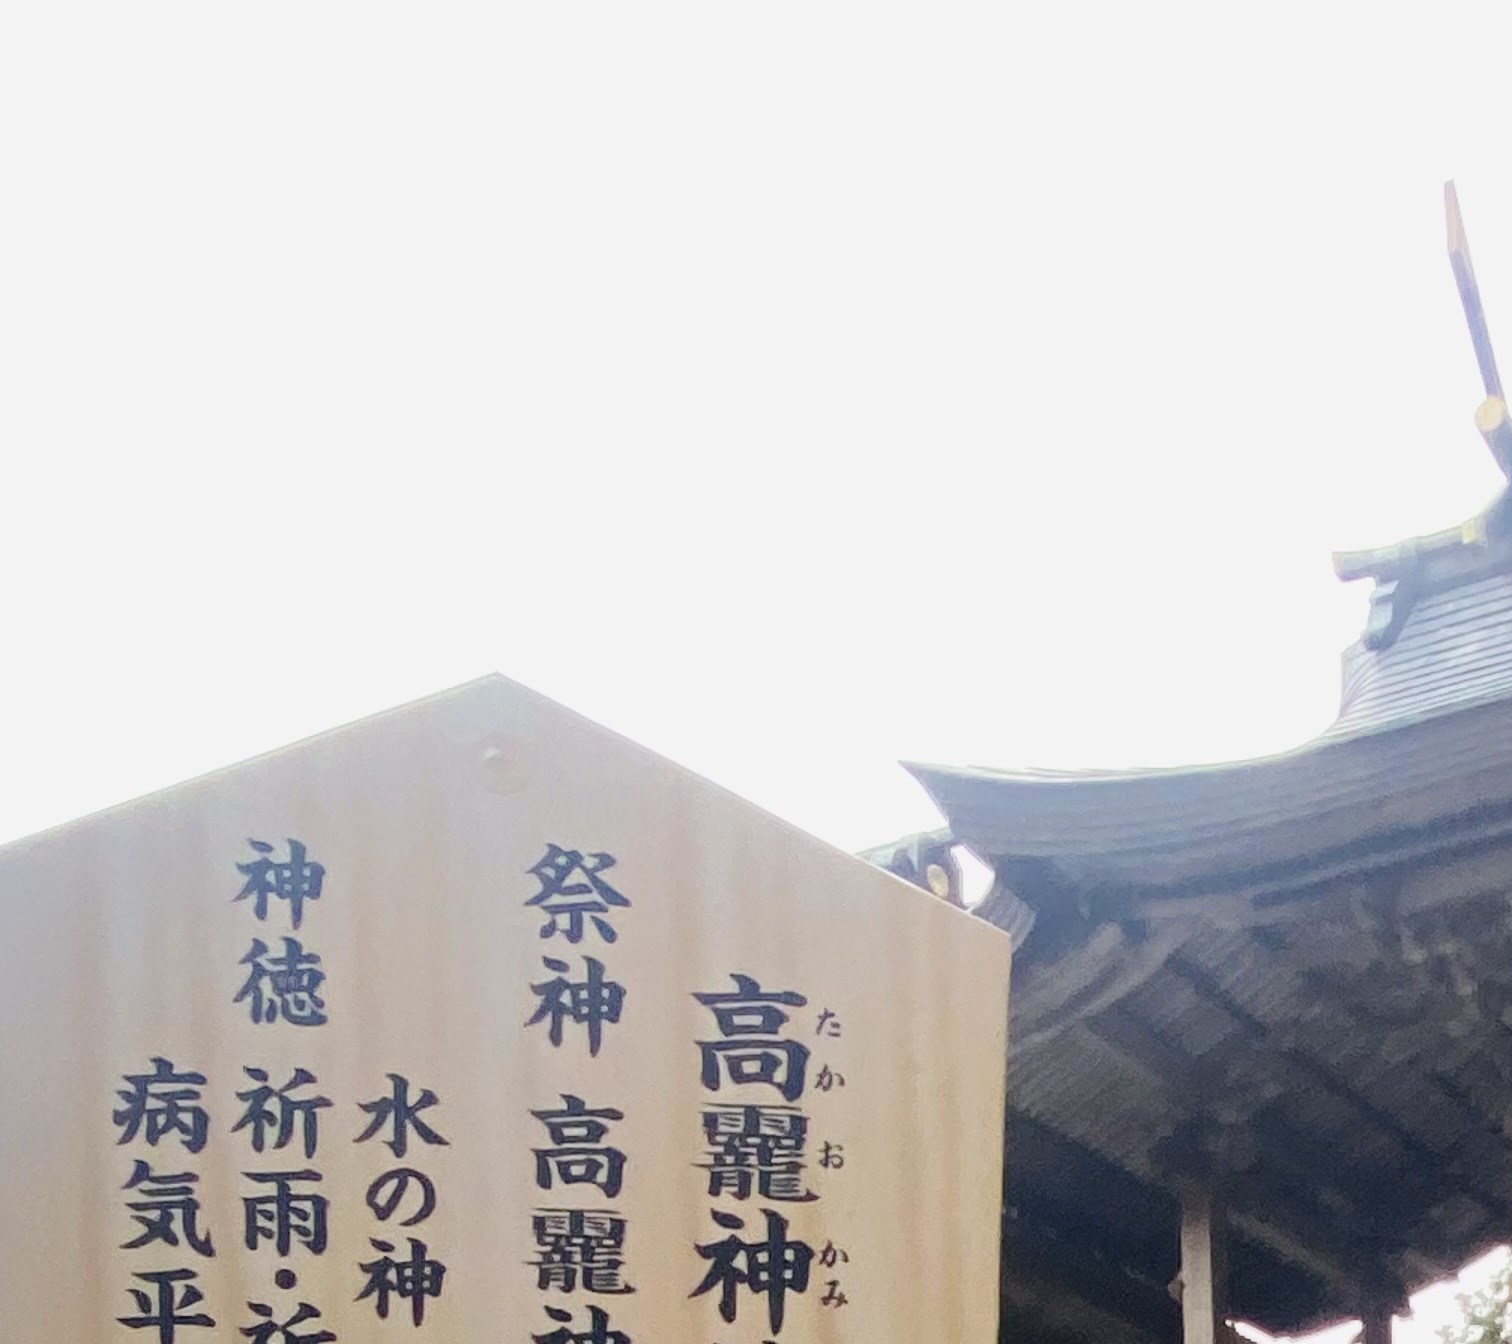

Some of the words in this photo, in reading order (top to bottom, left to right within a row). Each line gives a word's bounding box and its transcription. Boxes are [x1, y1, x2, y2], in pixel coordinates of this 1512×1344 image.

[232, 837, 330, 1028] 神徳
[522, 842, 633, 1060] 祭神
[351, 1071, 452, 1330] 水の神
